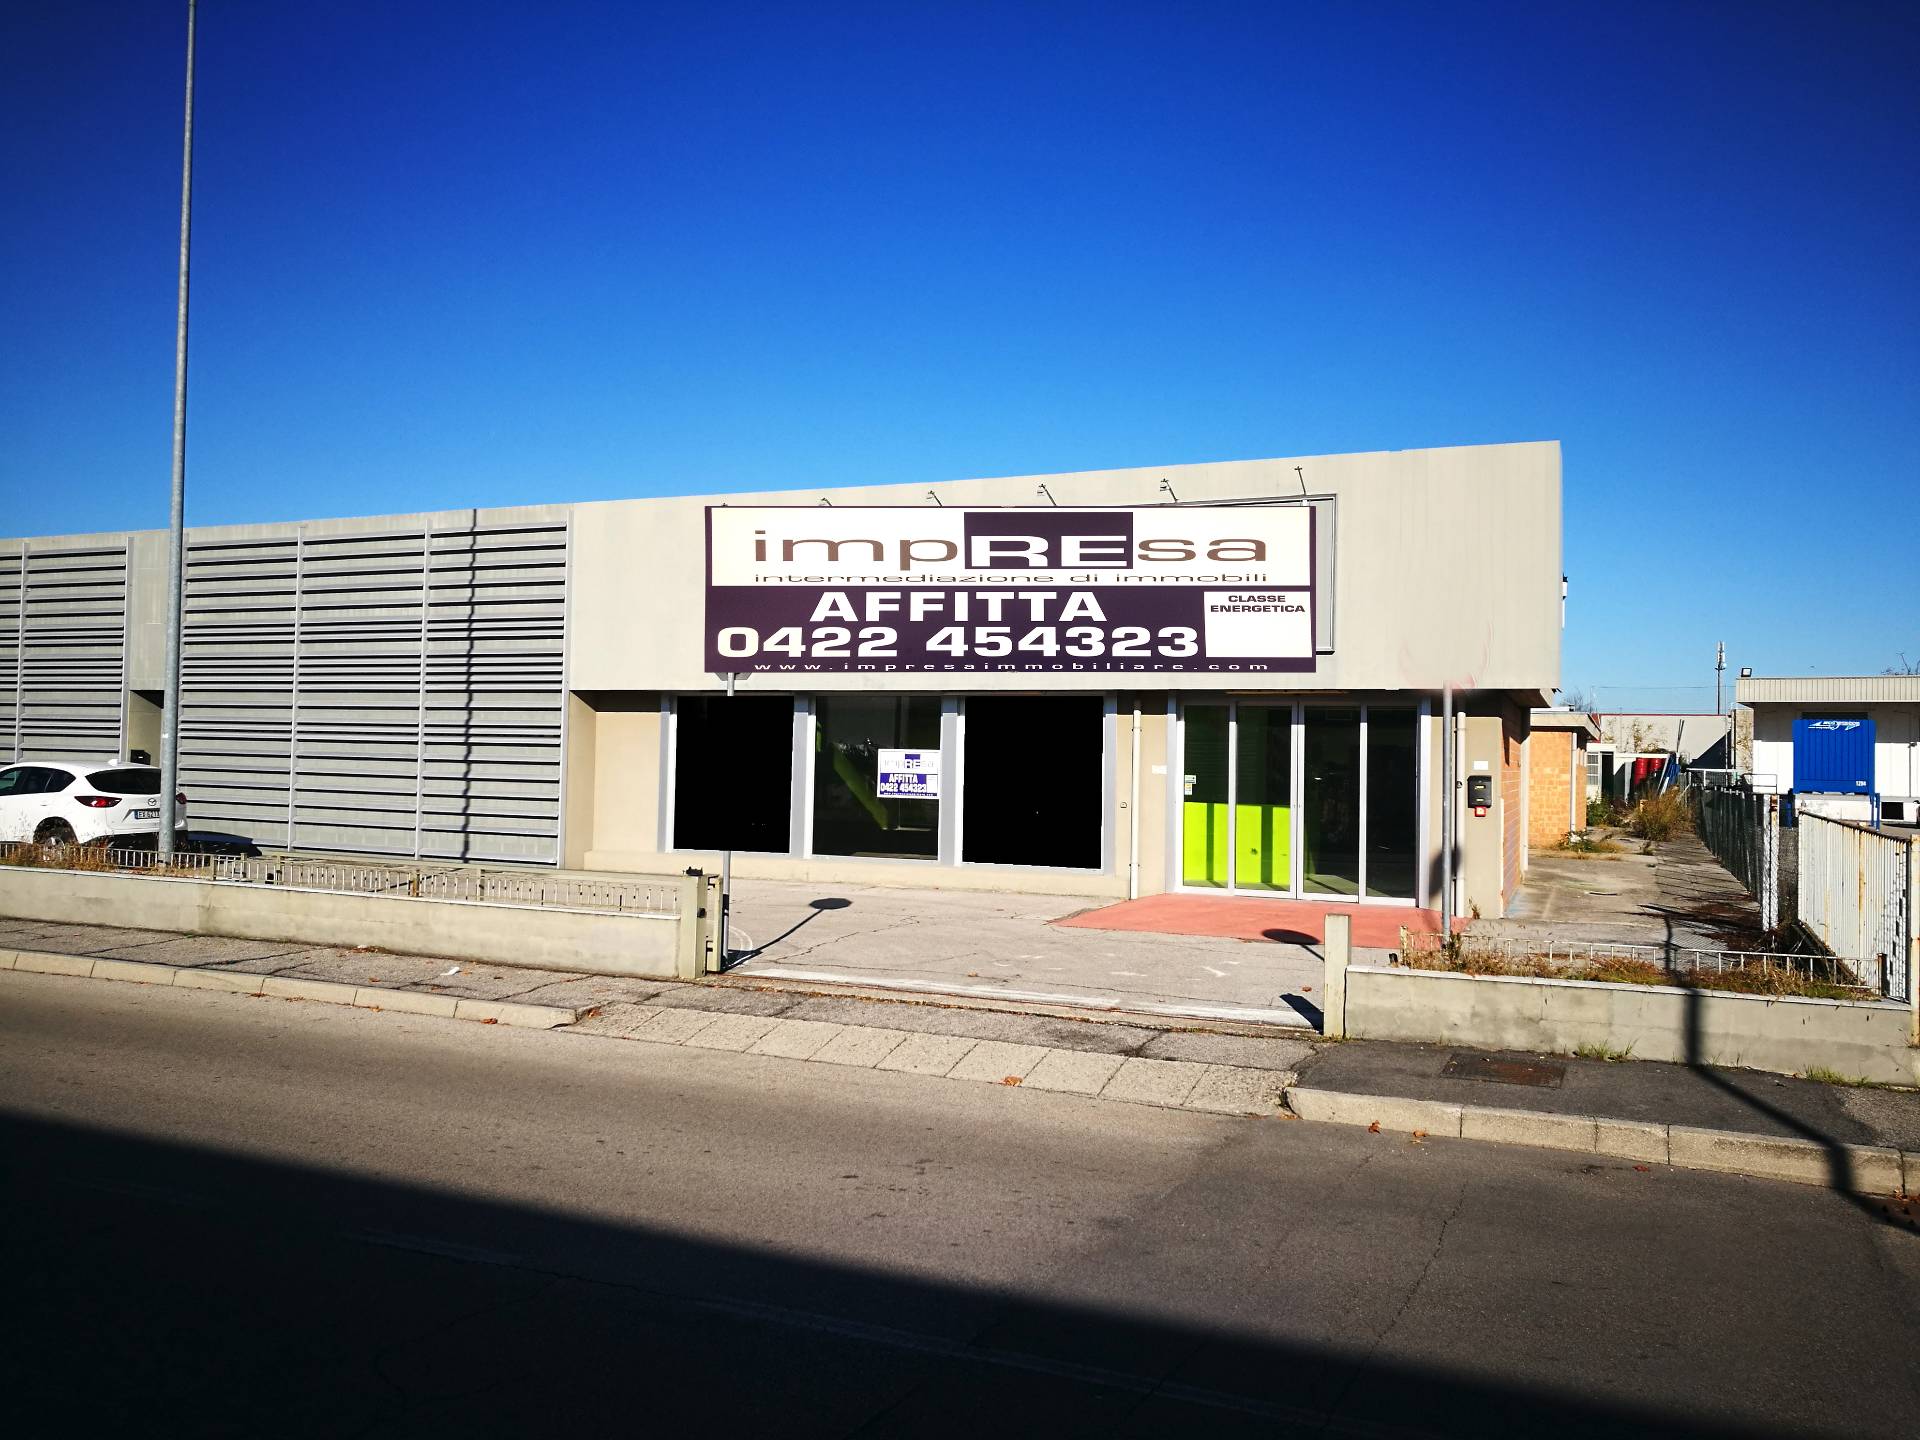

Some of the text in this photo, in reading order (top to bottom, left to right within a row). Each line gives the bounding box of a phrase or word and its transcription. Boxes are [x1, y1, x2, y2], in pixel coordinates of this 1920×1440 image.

[755, 530, 1267, 571] impREsa
[755, 574, 1267, 583] intermediazione di immobili
[1228, 595, 1286, 603] CLASSE
[809, 591, 1108, 622] AFFITTA
[1210, 604, 1306, 613] ENERGETICA
[717, 626, 1199, 658] 0422 454323
[888, 773, 919, 784] AFFITTA
